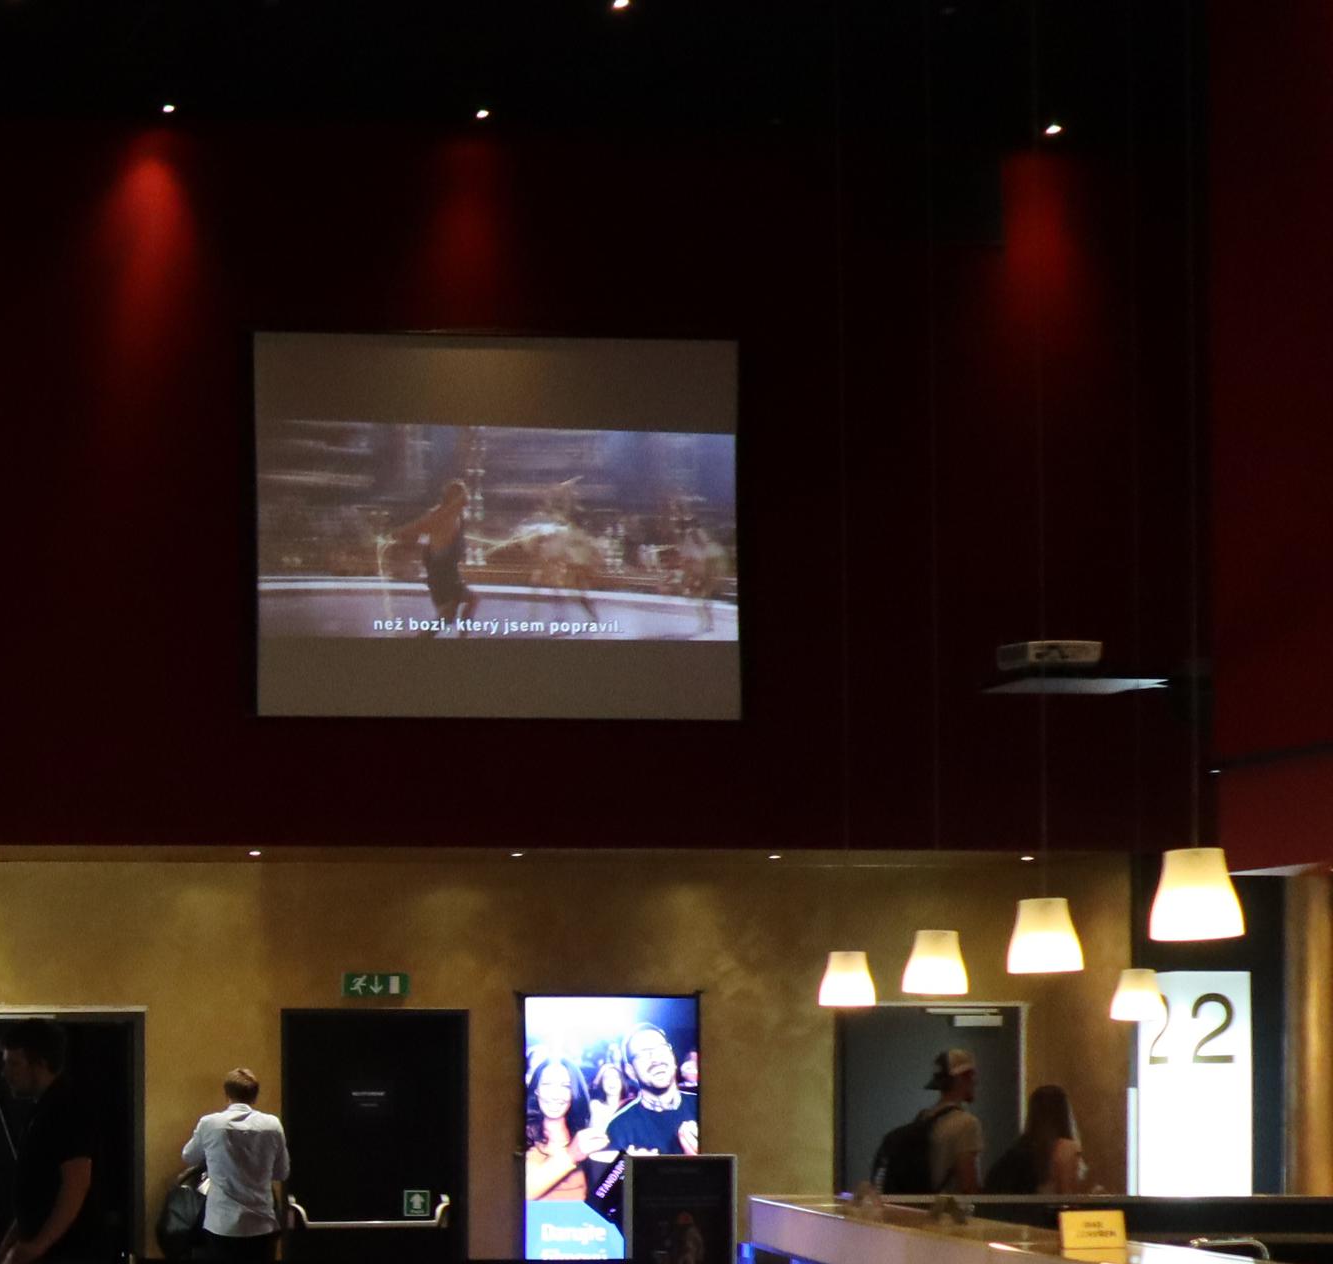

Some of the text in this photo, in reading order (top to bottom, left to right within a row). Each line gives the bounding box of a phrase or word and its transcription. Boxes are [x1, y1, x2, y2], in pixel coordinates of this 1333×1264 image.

[373, 617, 403, 631] než
[455, 617, 499, 635] který
[503, 618, 545, 635] jsem
[549, 619, 624, 636] popravil.
[1191, 992, 1236, 1064] 2
[541, 1222, 607, 1245] Darujte
